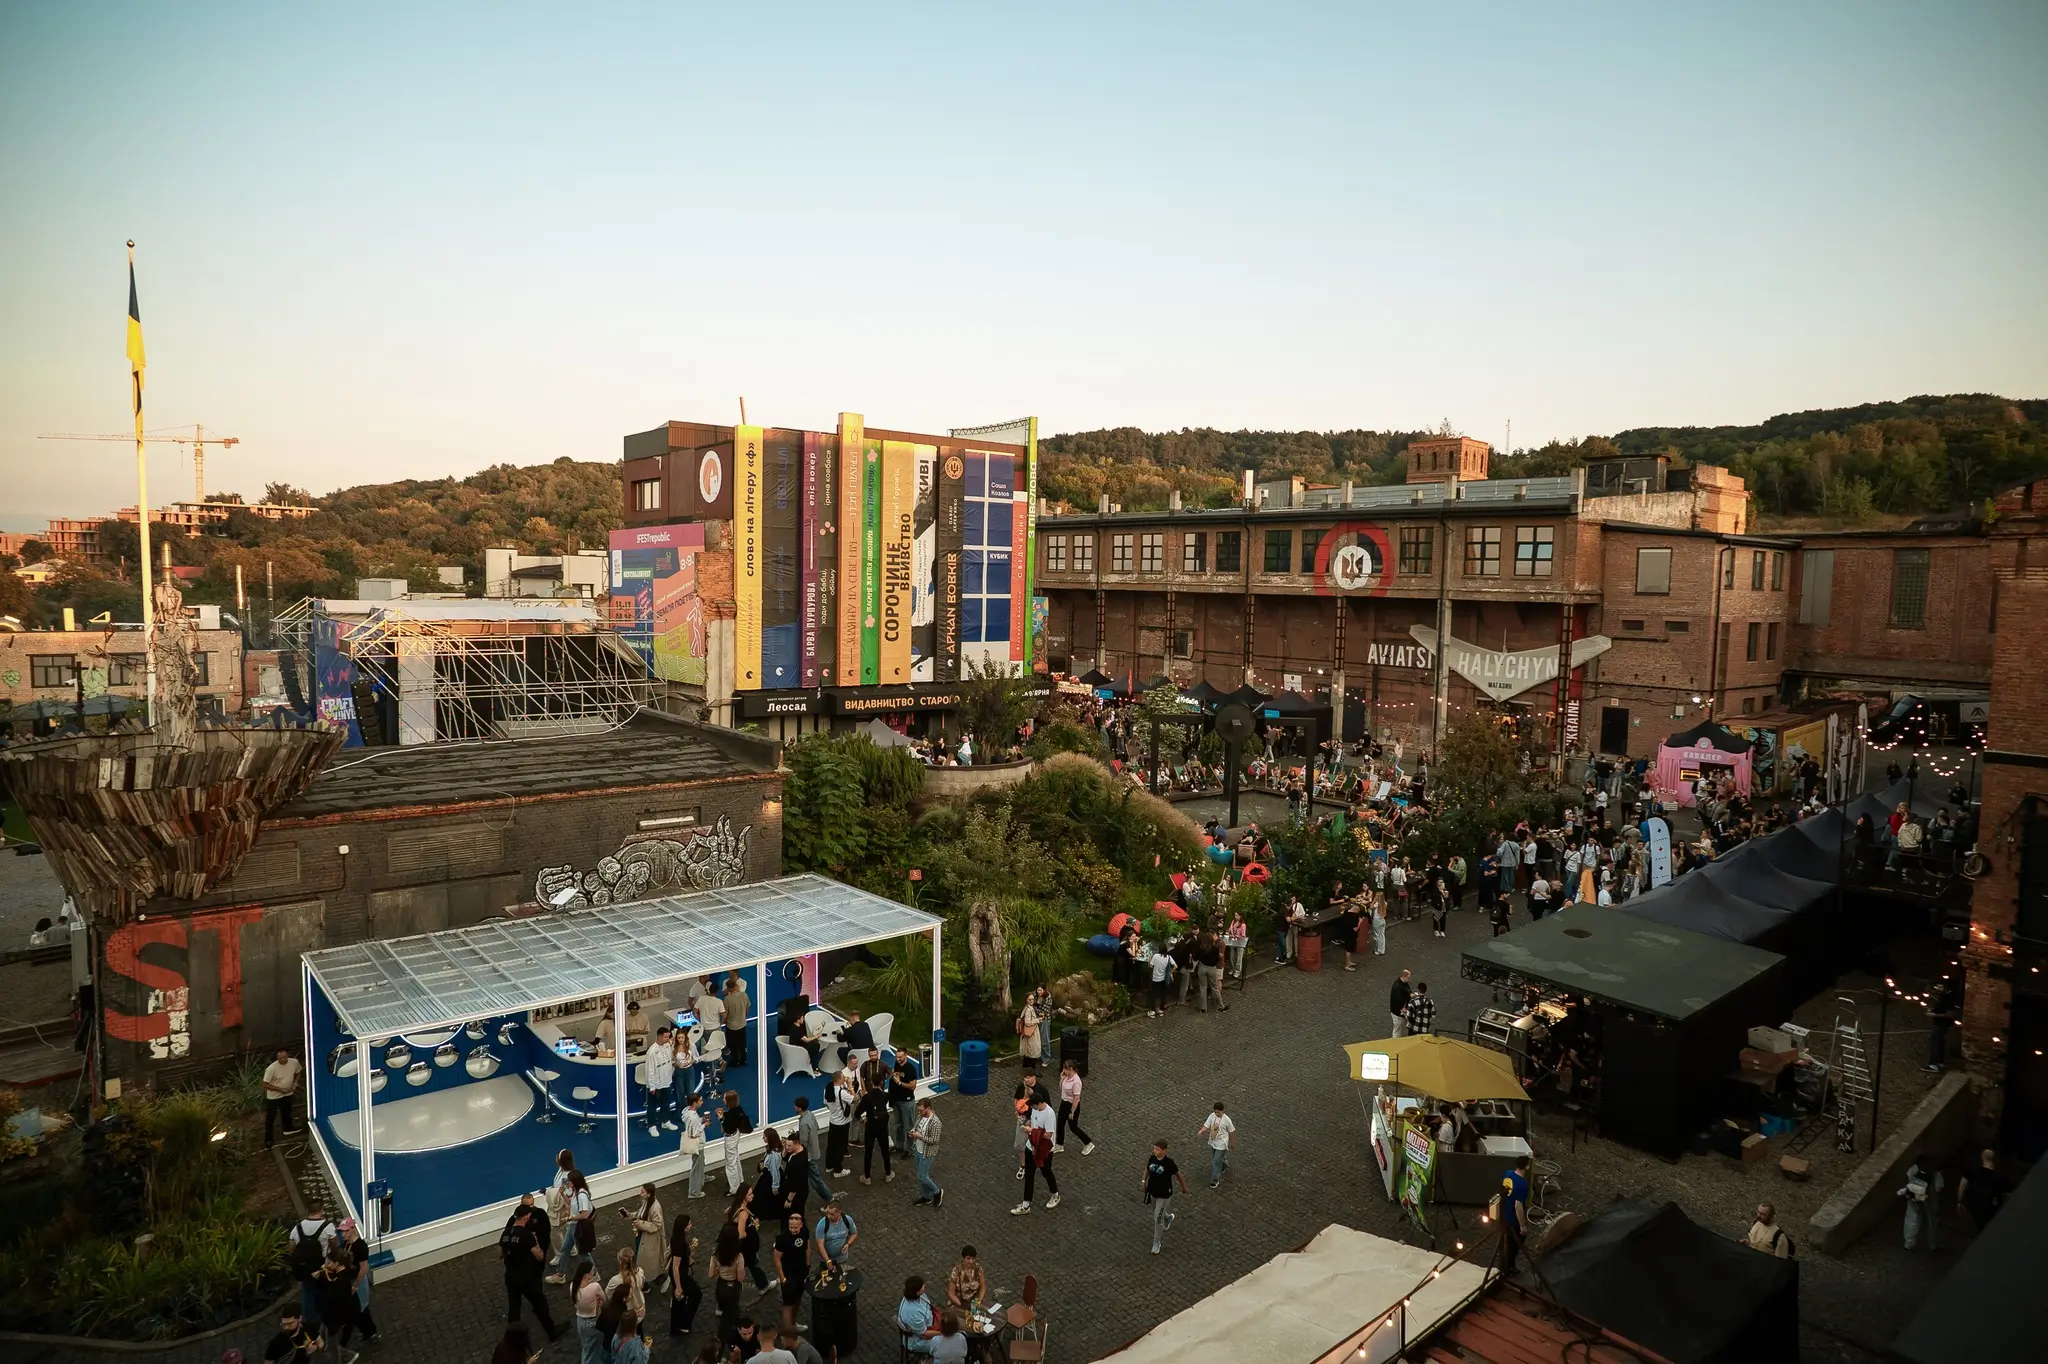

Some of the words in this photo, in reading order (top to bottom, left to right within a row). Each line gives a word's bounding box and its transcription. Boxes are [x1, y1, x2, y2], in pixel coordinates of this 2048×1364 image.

[745, 442, 757, 468] «ф»
[745, 471, 757, 514] літеру
[745, 516, 755, 533] на
[745, 537, 755, 577] слово
[900, 513, 911, 591] ВБИВСТВО
[989, 552, 1009, 560] КУБИК
[1017, 513, 1025, 579] СВІДЧЕННЯ
[847, 560, 858, 584] СЕБЕ
[946, 552, 957, 604] ВОВКІВ
[806, 581, 816, 628] ПУРПУРОВА
[847, 585, 858, 600] НА
[884, 541, 901, 642] СОРОЧИНЕ
[820, 607, 828, 625] ходи
[946, 606, 957, 654] АРКАН
[806, 631, 816, 657] БАРВА
[1367, 643, 1433, 669] AVIATSI
[1457, 651, 1560, 681] HALYCHYN
[1487, 682, 1513, 690] МАГАЗИН
[766, 702, 807, 712] Леосад
[844, 697, 915, 711] ВИДАВНИЦТВО
[1683, 751, 1723, 761] КАВАЛЕР
[1406, 1129, 1429, 1154] MOJITO
